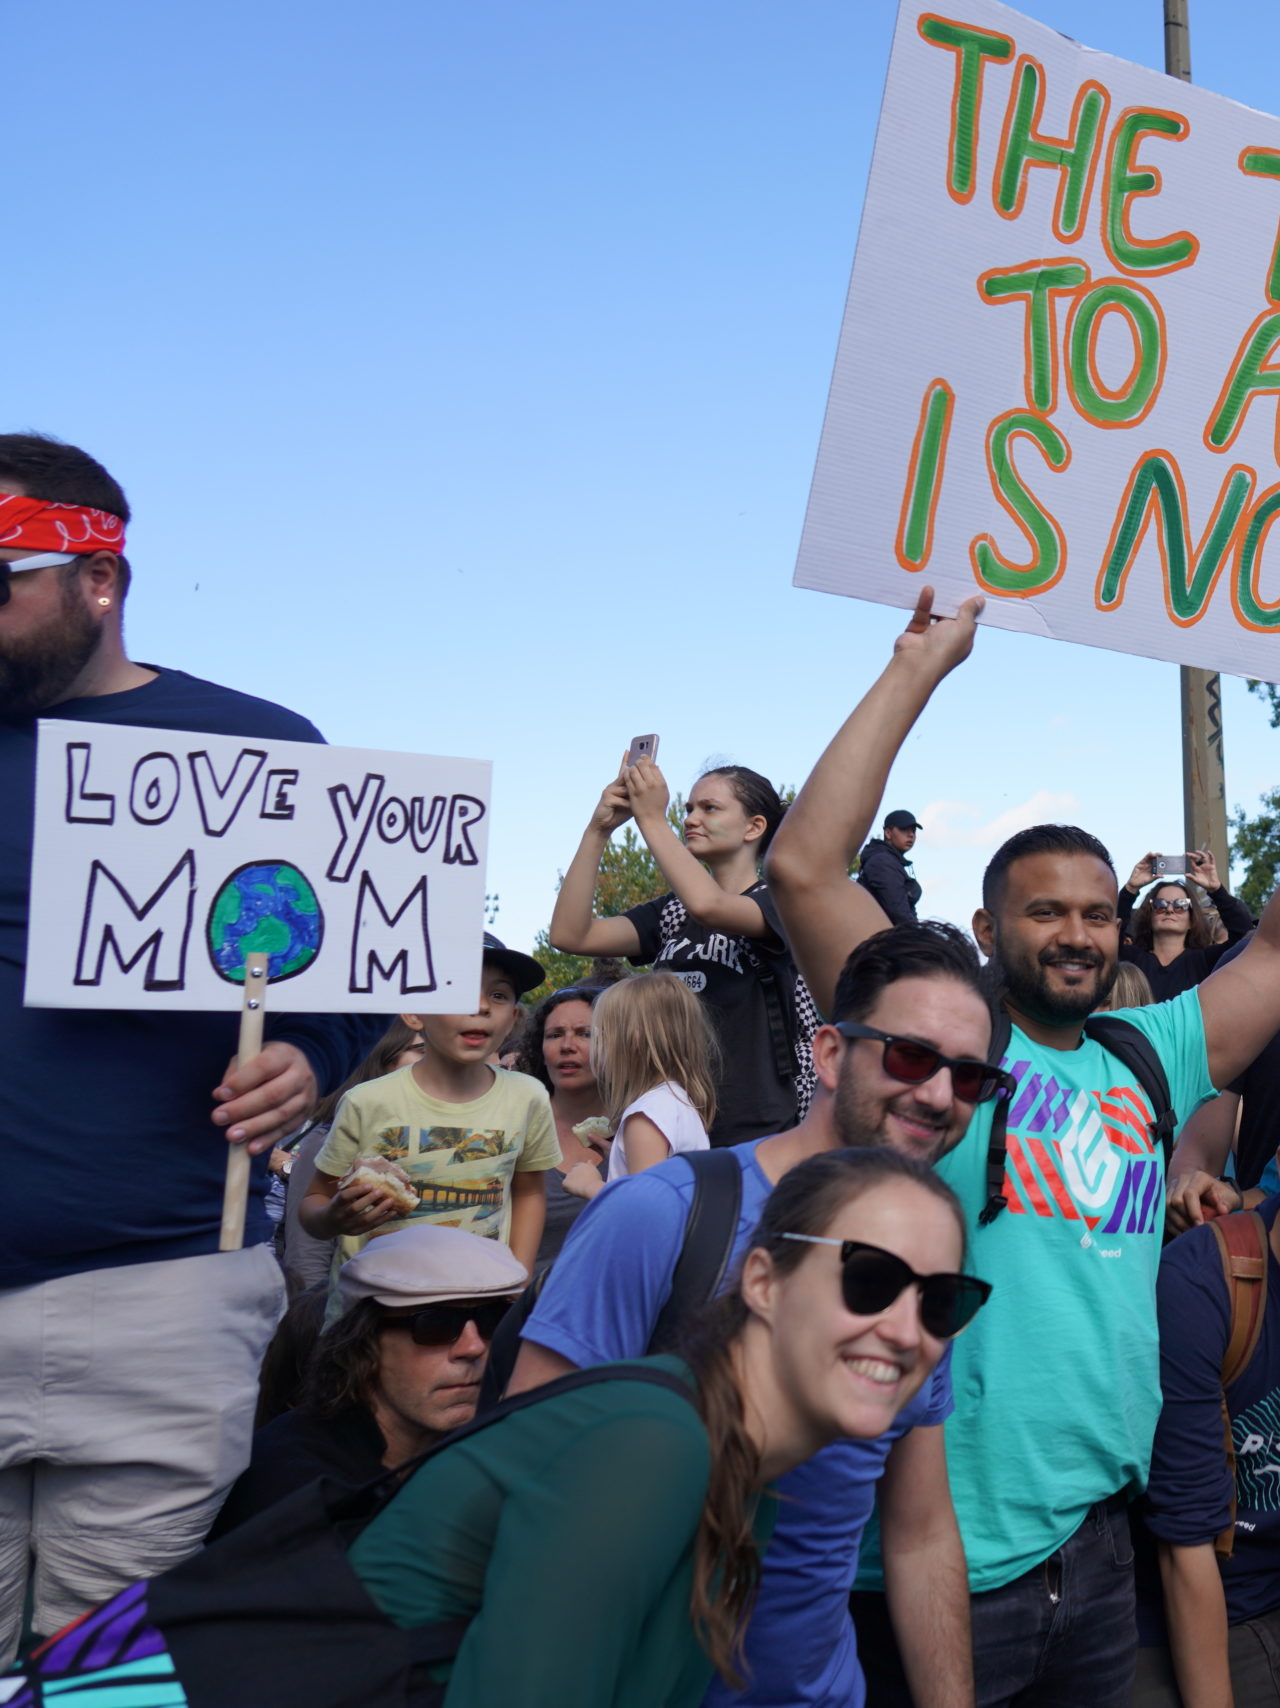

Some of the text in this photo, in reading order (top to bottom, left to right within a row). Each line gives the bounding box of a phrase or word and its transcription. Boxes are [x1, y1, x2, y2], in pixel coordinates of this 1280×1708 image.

[917, 13, 1199, 276] THE
[977, 257, 1167, 430] TO
[894, 377, 1071, 598] IS
[65, 742, 486, 882] LOVE YOUR
